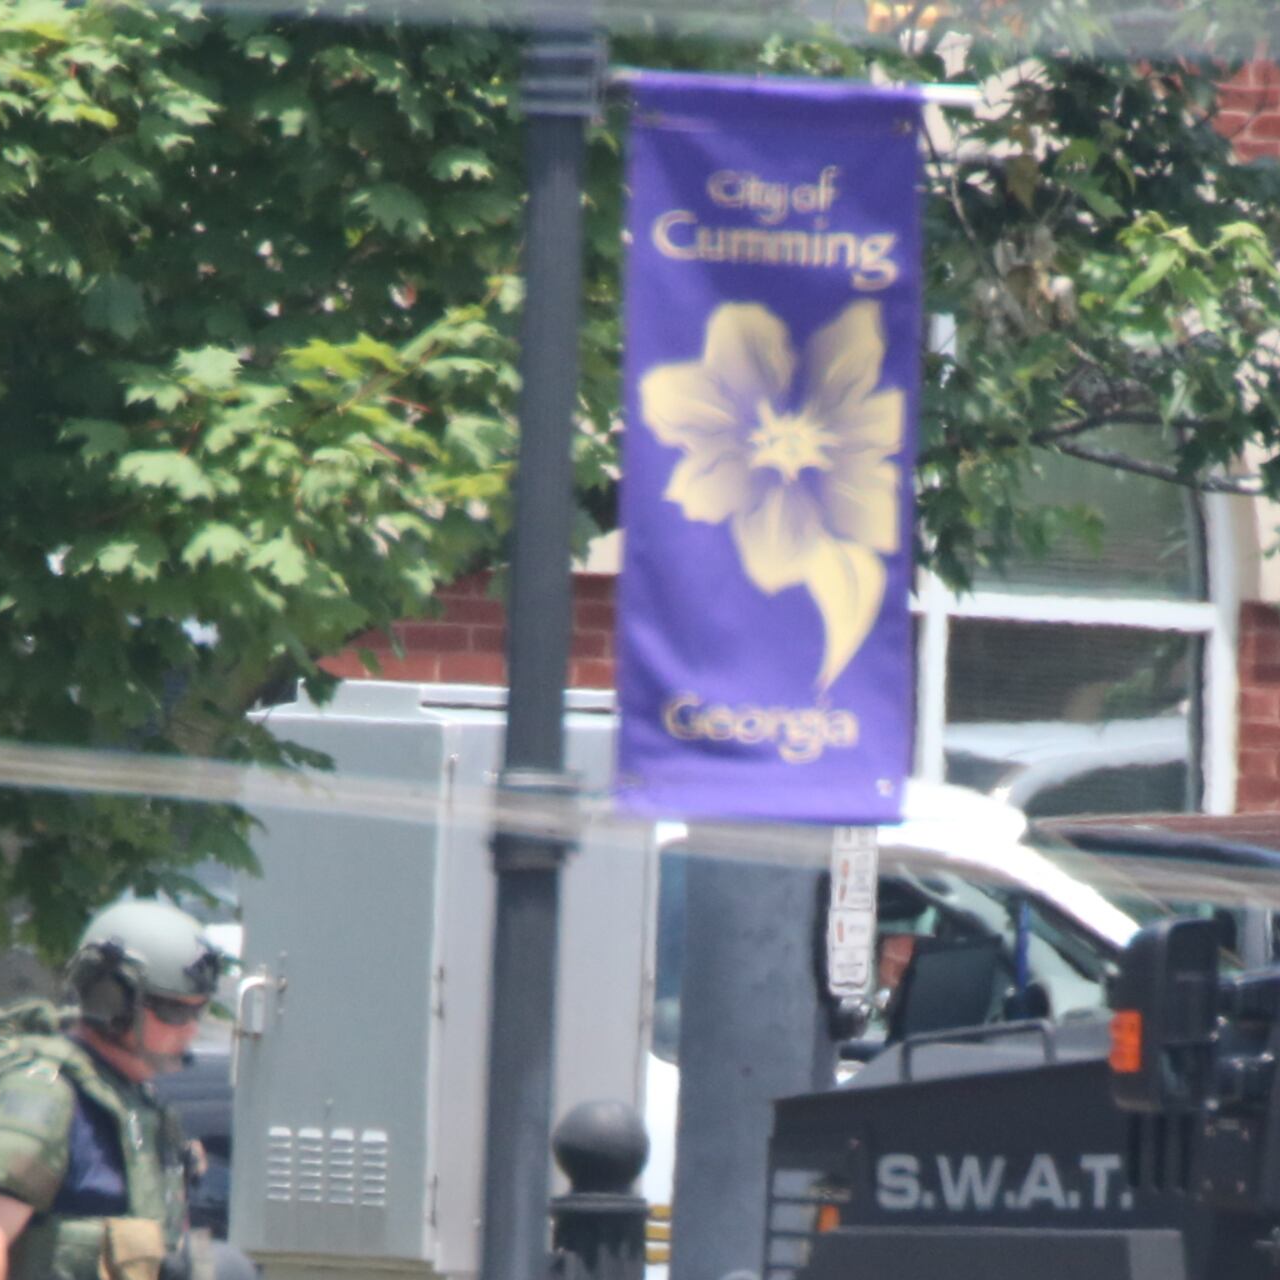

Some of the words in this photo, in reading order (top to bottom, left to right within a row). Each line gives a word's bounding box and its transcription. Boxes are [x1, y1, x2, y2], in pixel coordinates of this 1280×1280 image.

[707, 169, 789, 225] City
[791, 164, 840, 214] of
[651, 209, 898, 291] Cumming
[664, 692, 859, 764] Georgia
[875, 1153, 1133, 1211] S.W.A.T.
